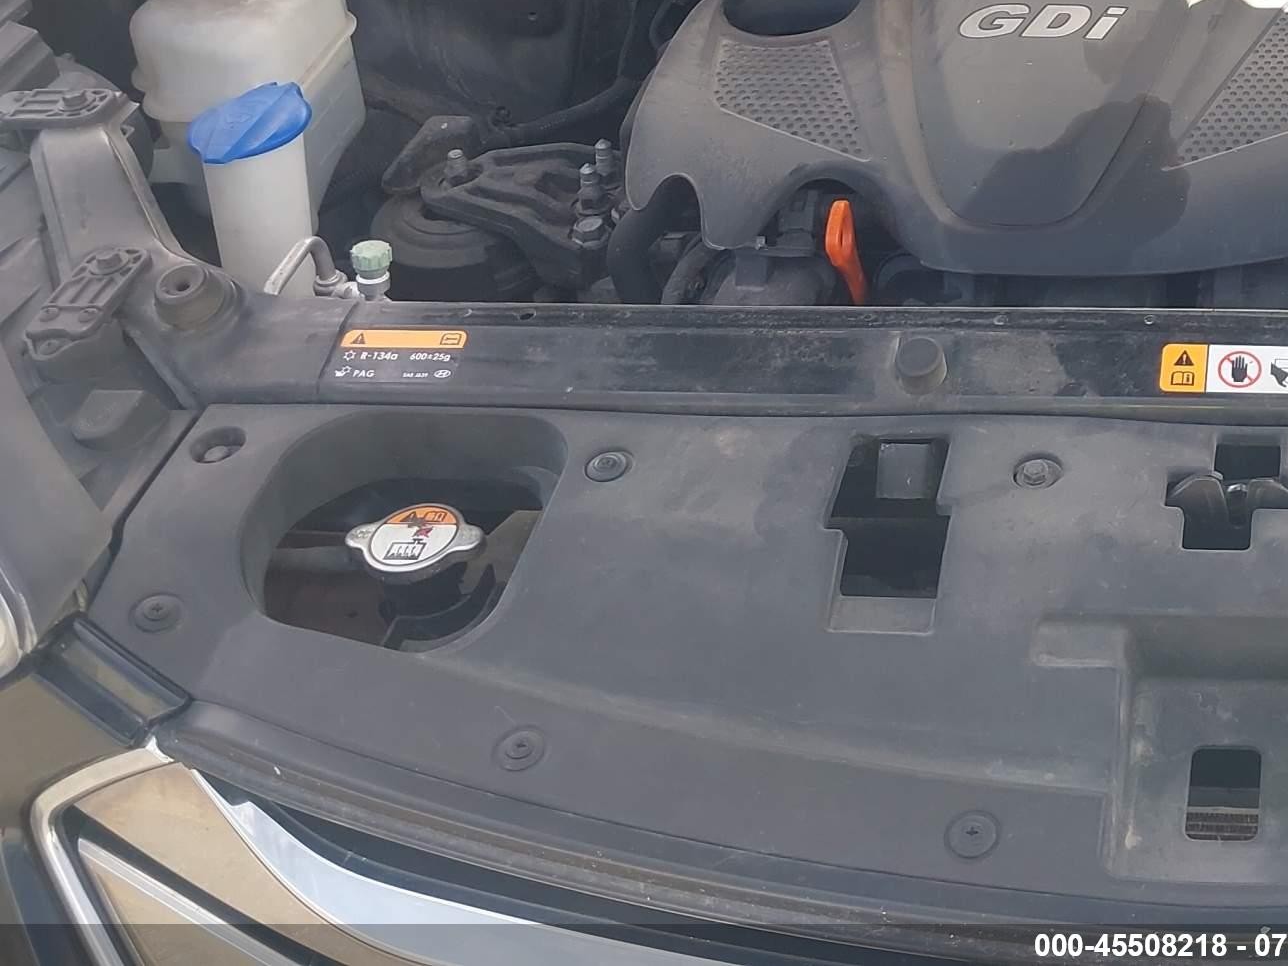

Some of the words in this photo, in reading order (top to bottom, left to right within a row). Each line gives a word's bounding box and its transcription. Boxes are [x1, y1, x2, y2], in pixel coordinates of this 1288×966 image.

[957, 3, 1128, 40] GDi
[360, 351, 399, 361] R-134a
[352, 369, 376, 378] PAG
